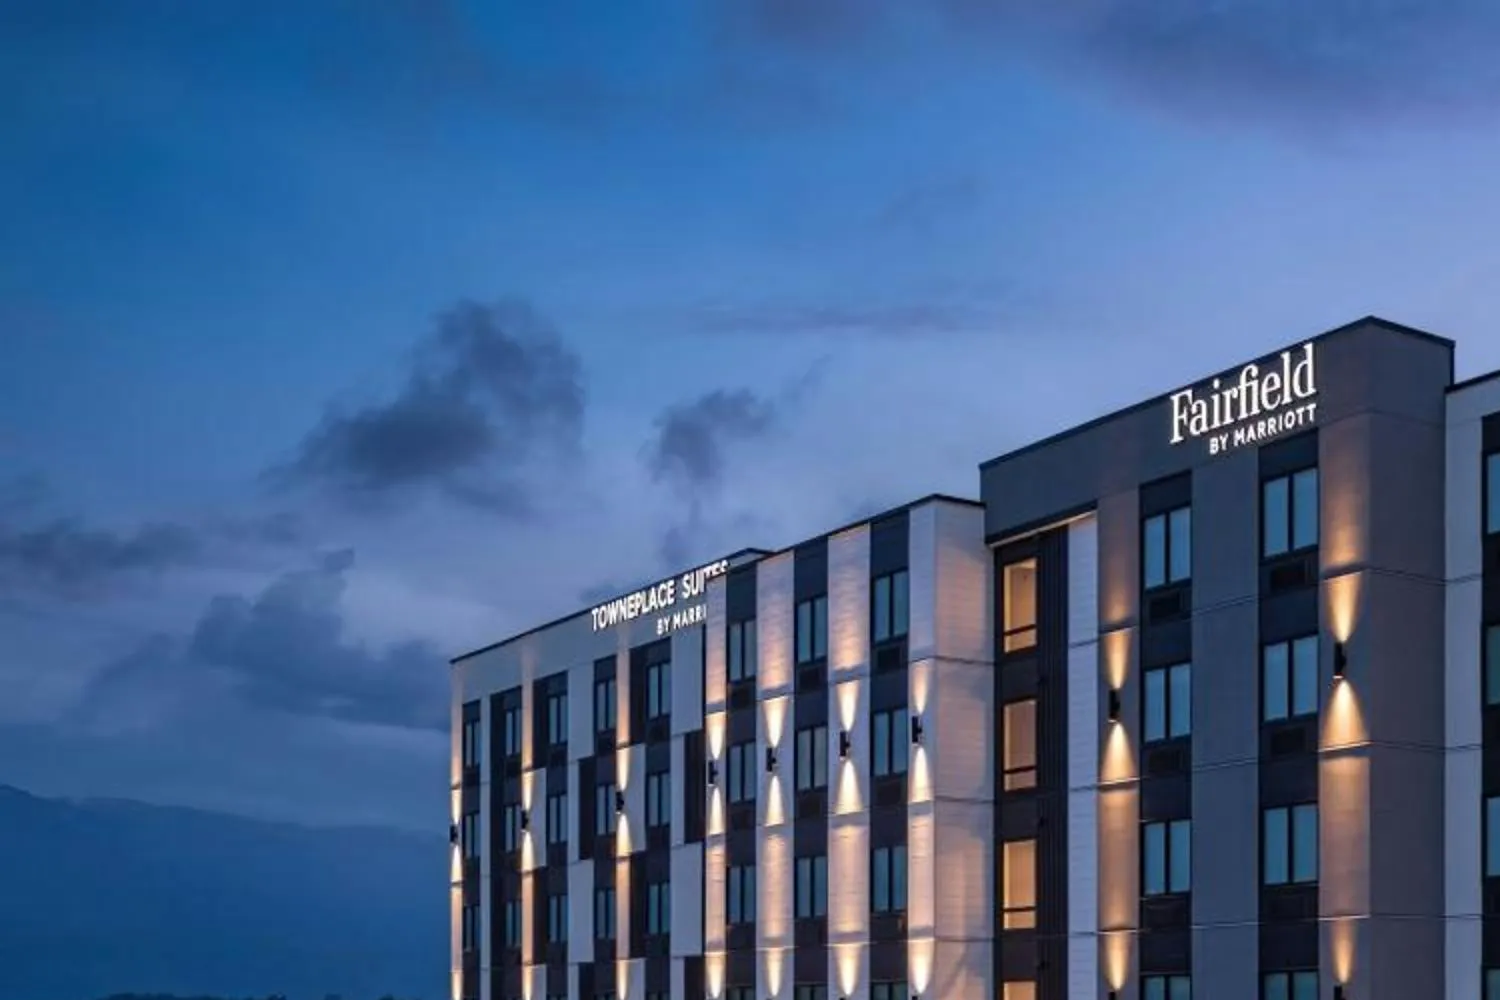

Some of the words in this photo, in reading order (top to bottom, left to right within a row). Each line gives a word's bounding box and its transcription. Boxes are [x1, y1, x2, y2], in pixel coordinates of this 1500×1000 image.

[1170, 342, 1317, 444] Fairfield
[1209, 433, 1229, 455] BY
[1233, 403, 1317, 447] MARRIOTT
[592, 580, 675, 632] TOWNEPLACE
[656, 616, 671, 635] BY
[673, 604, 707, 630] MARRI
